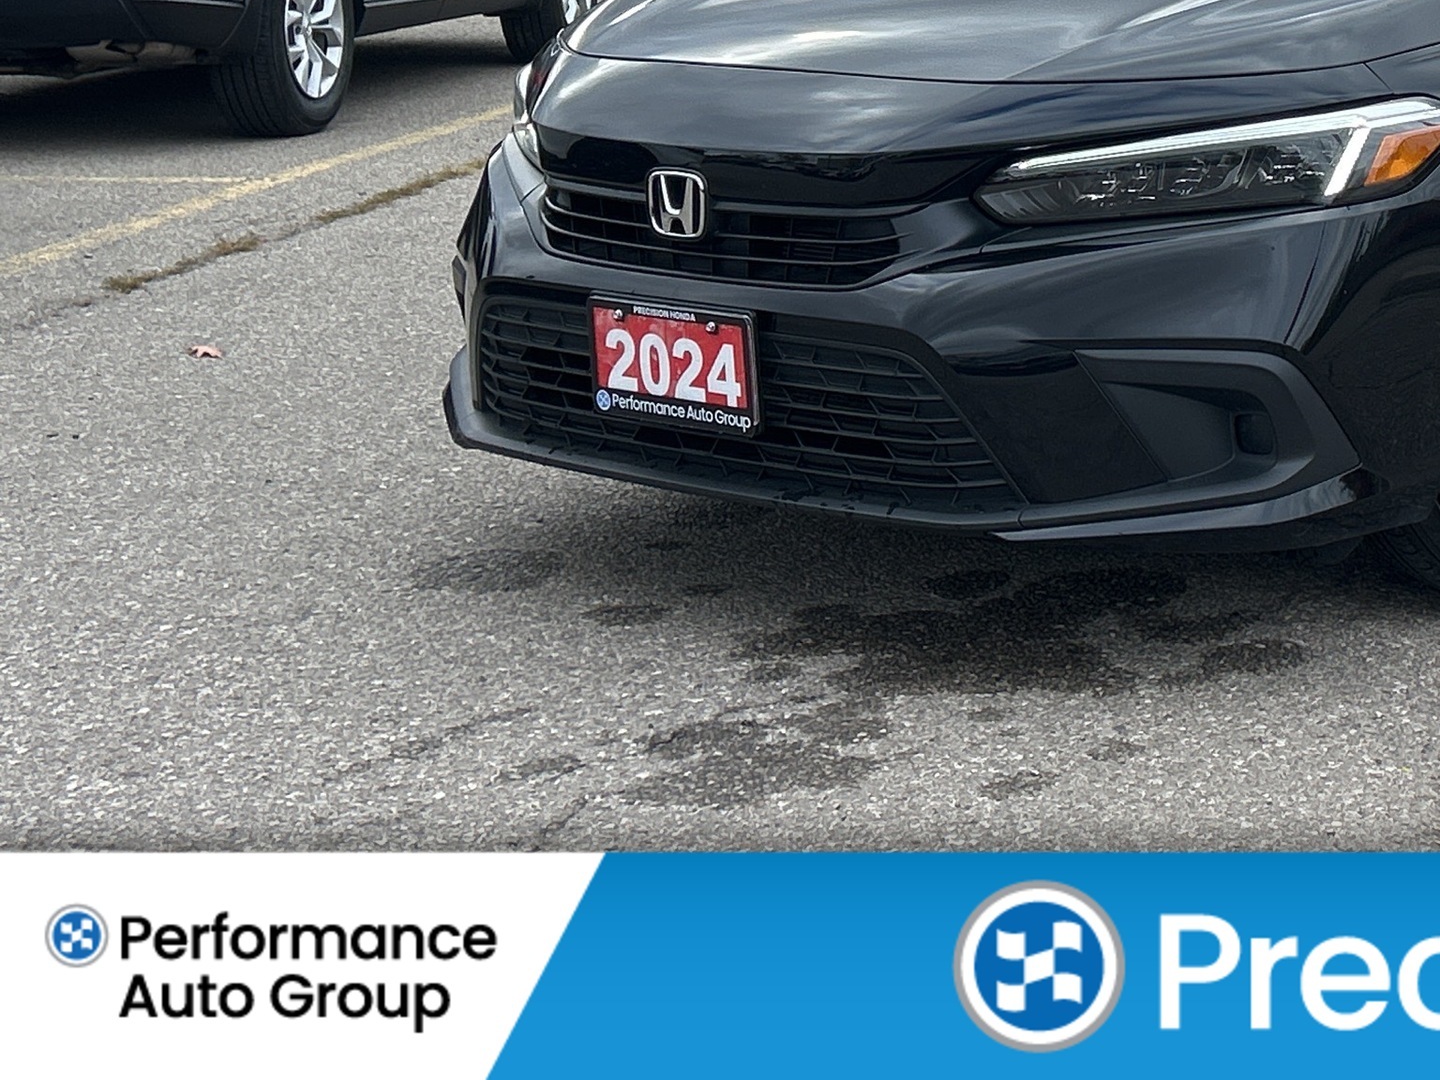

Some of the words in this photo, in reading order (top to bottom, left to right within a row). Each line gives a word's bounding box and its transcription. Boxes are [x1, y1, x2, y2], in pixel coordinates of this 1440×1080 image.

[633, 305, 669, 319] PRECISION
[669, 310, 697, 322] HONDA
[605, 327, 742, 409] 2024
[611, 392, 685, 419] Performance
[686, 404, 714, 424] Auto
[714, 409, 752, 433] Group
